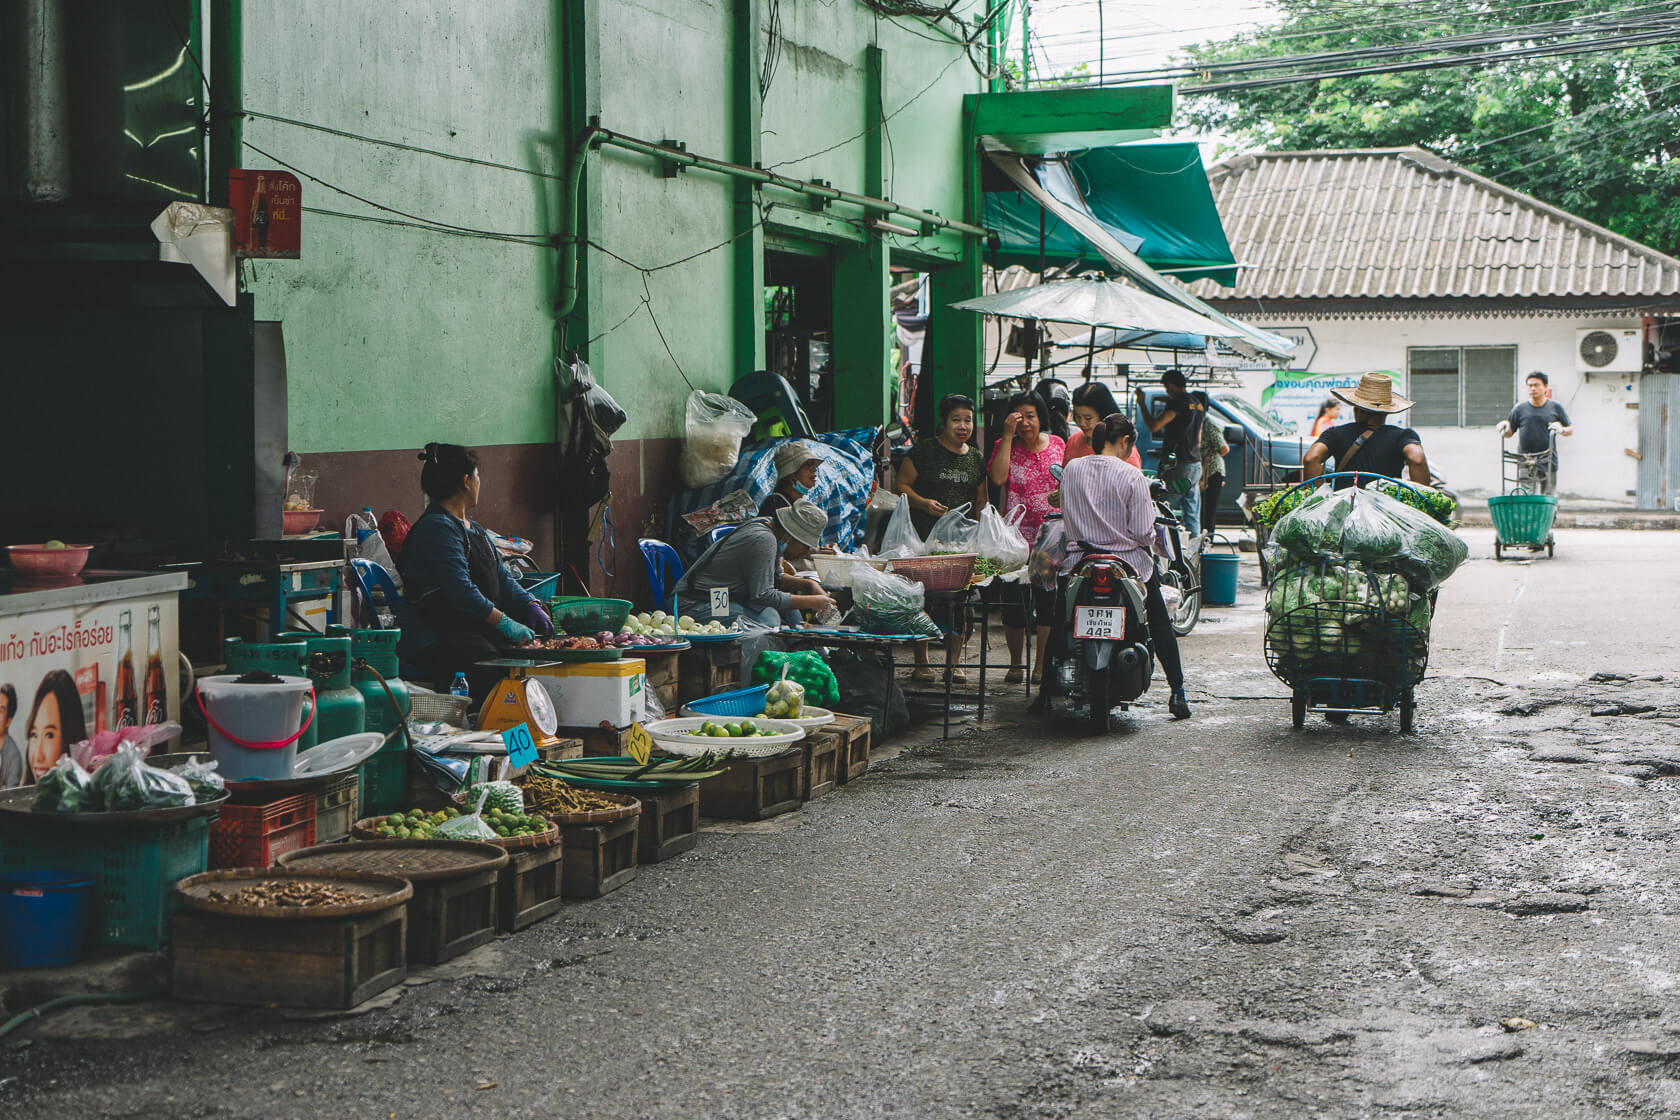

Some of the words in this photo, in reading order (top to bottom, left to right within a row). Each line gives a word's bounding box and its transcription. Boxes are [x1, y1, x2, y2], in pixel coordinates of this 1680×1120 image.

[713, 591, 728, 609] 30
[30, 620, 113, 657] กับอะไรก็อร่อย
[1086, 627, 1111, 637] 442
[507, 728, 530, 757] 40
[629, 727, 648, 764] 25
